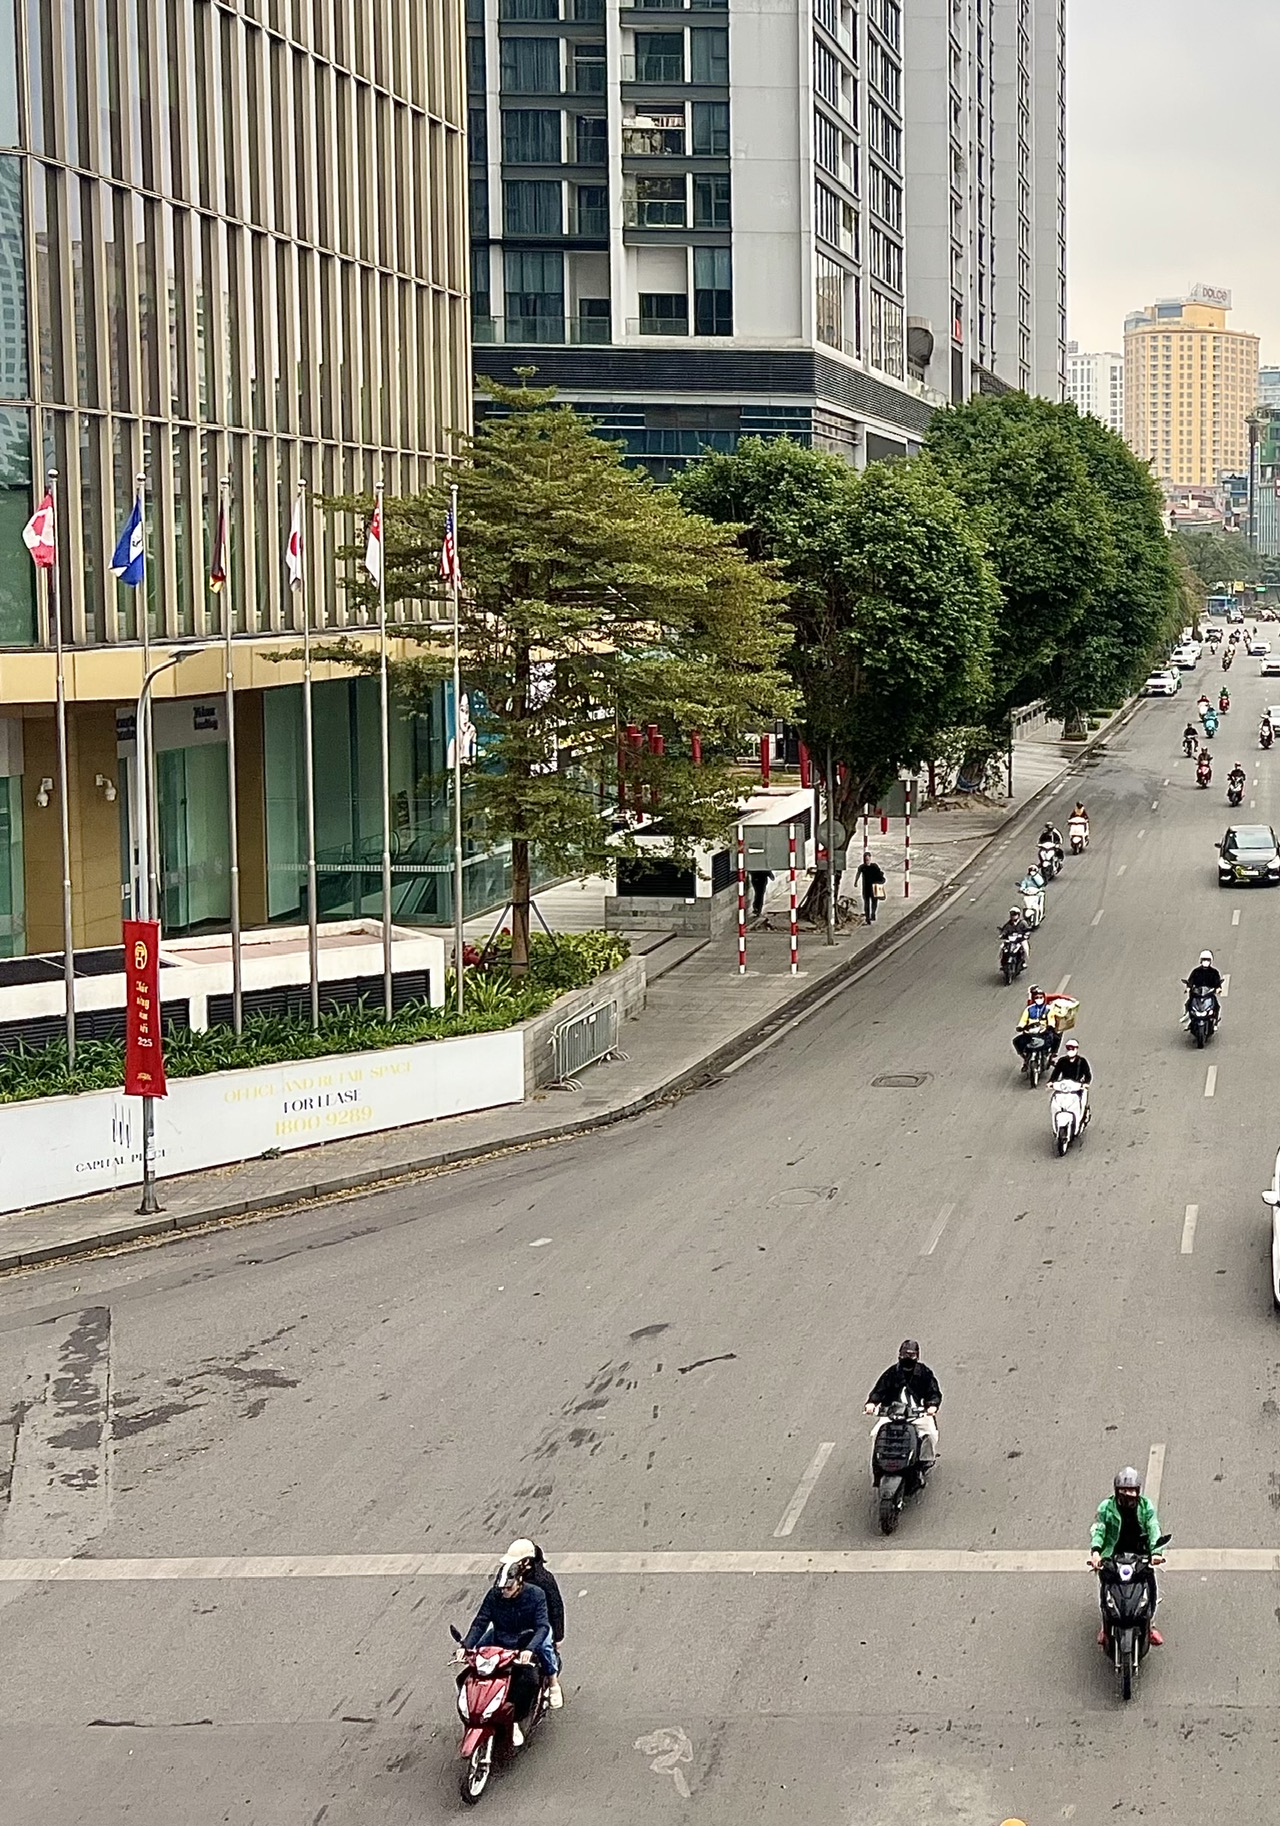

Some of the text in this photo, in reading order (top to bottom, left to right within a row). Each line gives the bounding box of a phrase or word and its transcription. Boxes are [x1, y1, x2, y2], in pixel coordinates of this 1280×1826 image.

[283, 1077, 314, 1093] AND
[370, 1061, 413, 1079] SPACE
[283, 1089, 361, 1114] FOR LEASE
[275, 1105, 373, 1137] 1800 9289
[131, 1149, 165, 1163] PLCE
